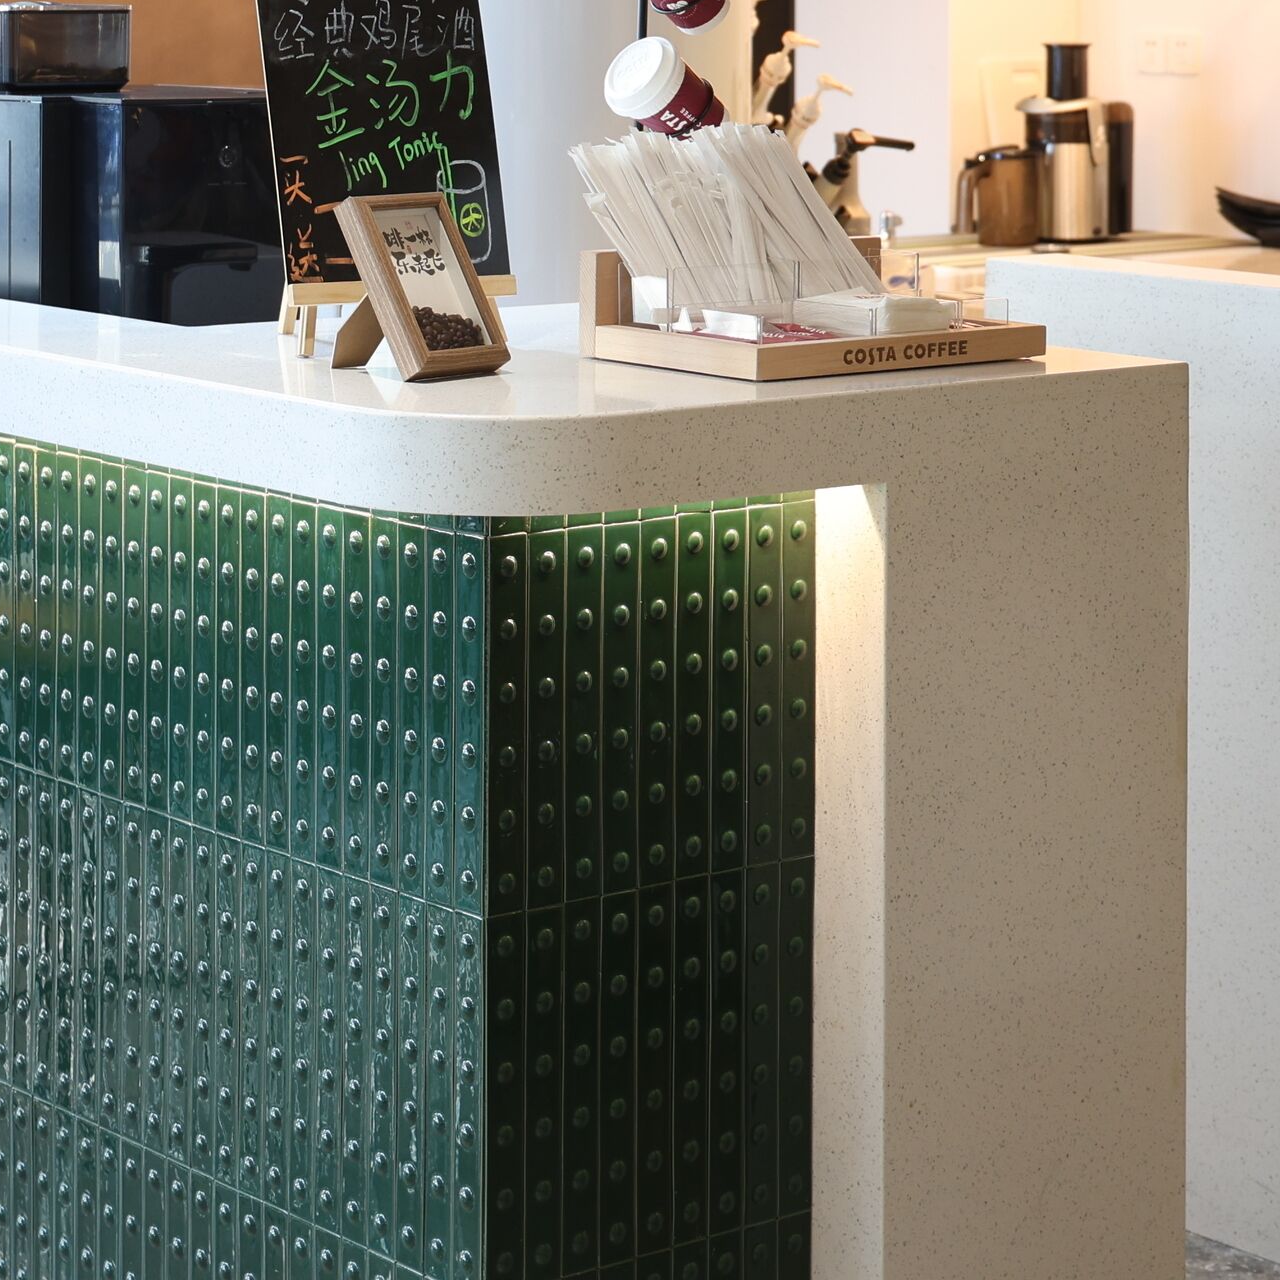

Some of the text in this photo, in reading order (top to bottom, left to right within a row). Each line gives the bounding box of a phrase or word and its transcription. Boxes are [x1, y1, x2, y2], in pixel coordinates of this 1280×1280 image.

[305, 50, 475, 150] 金汤力
[842, 339, 968, 366] COSTA COFFEE
